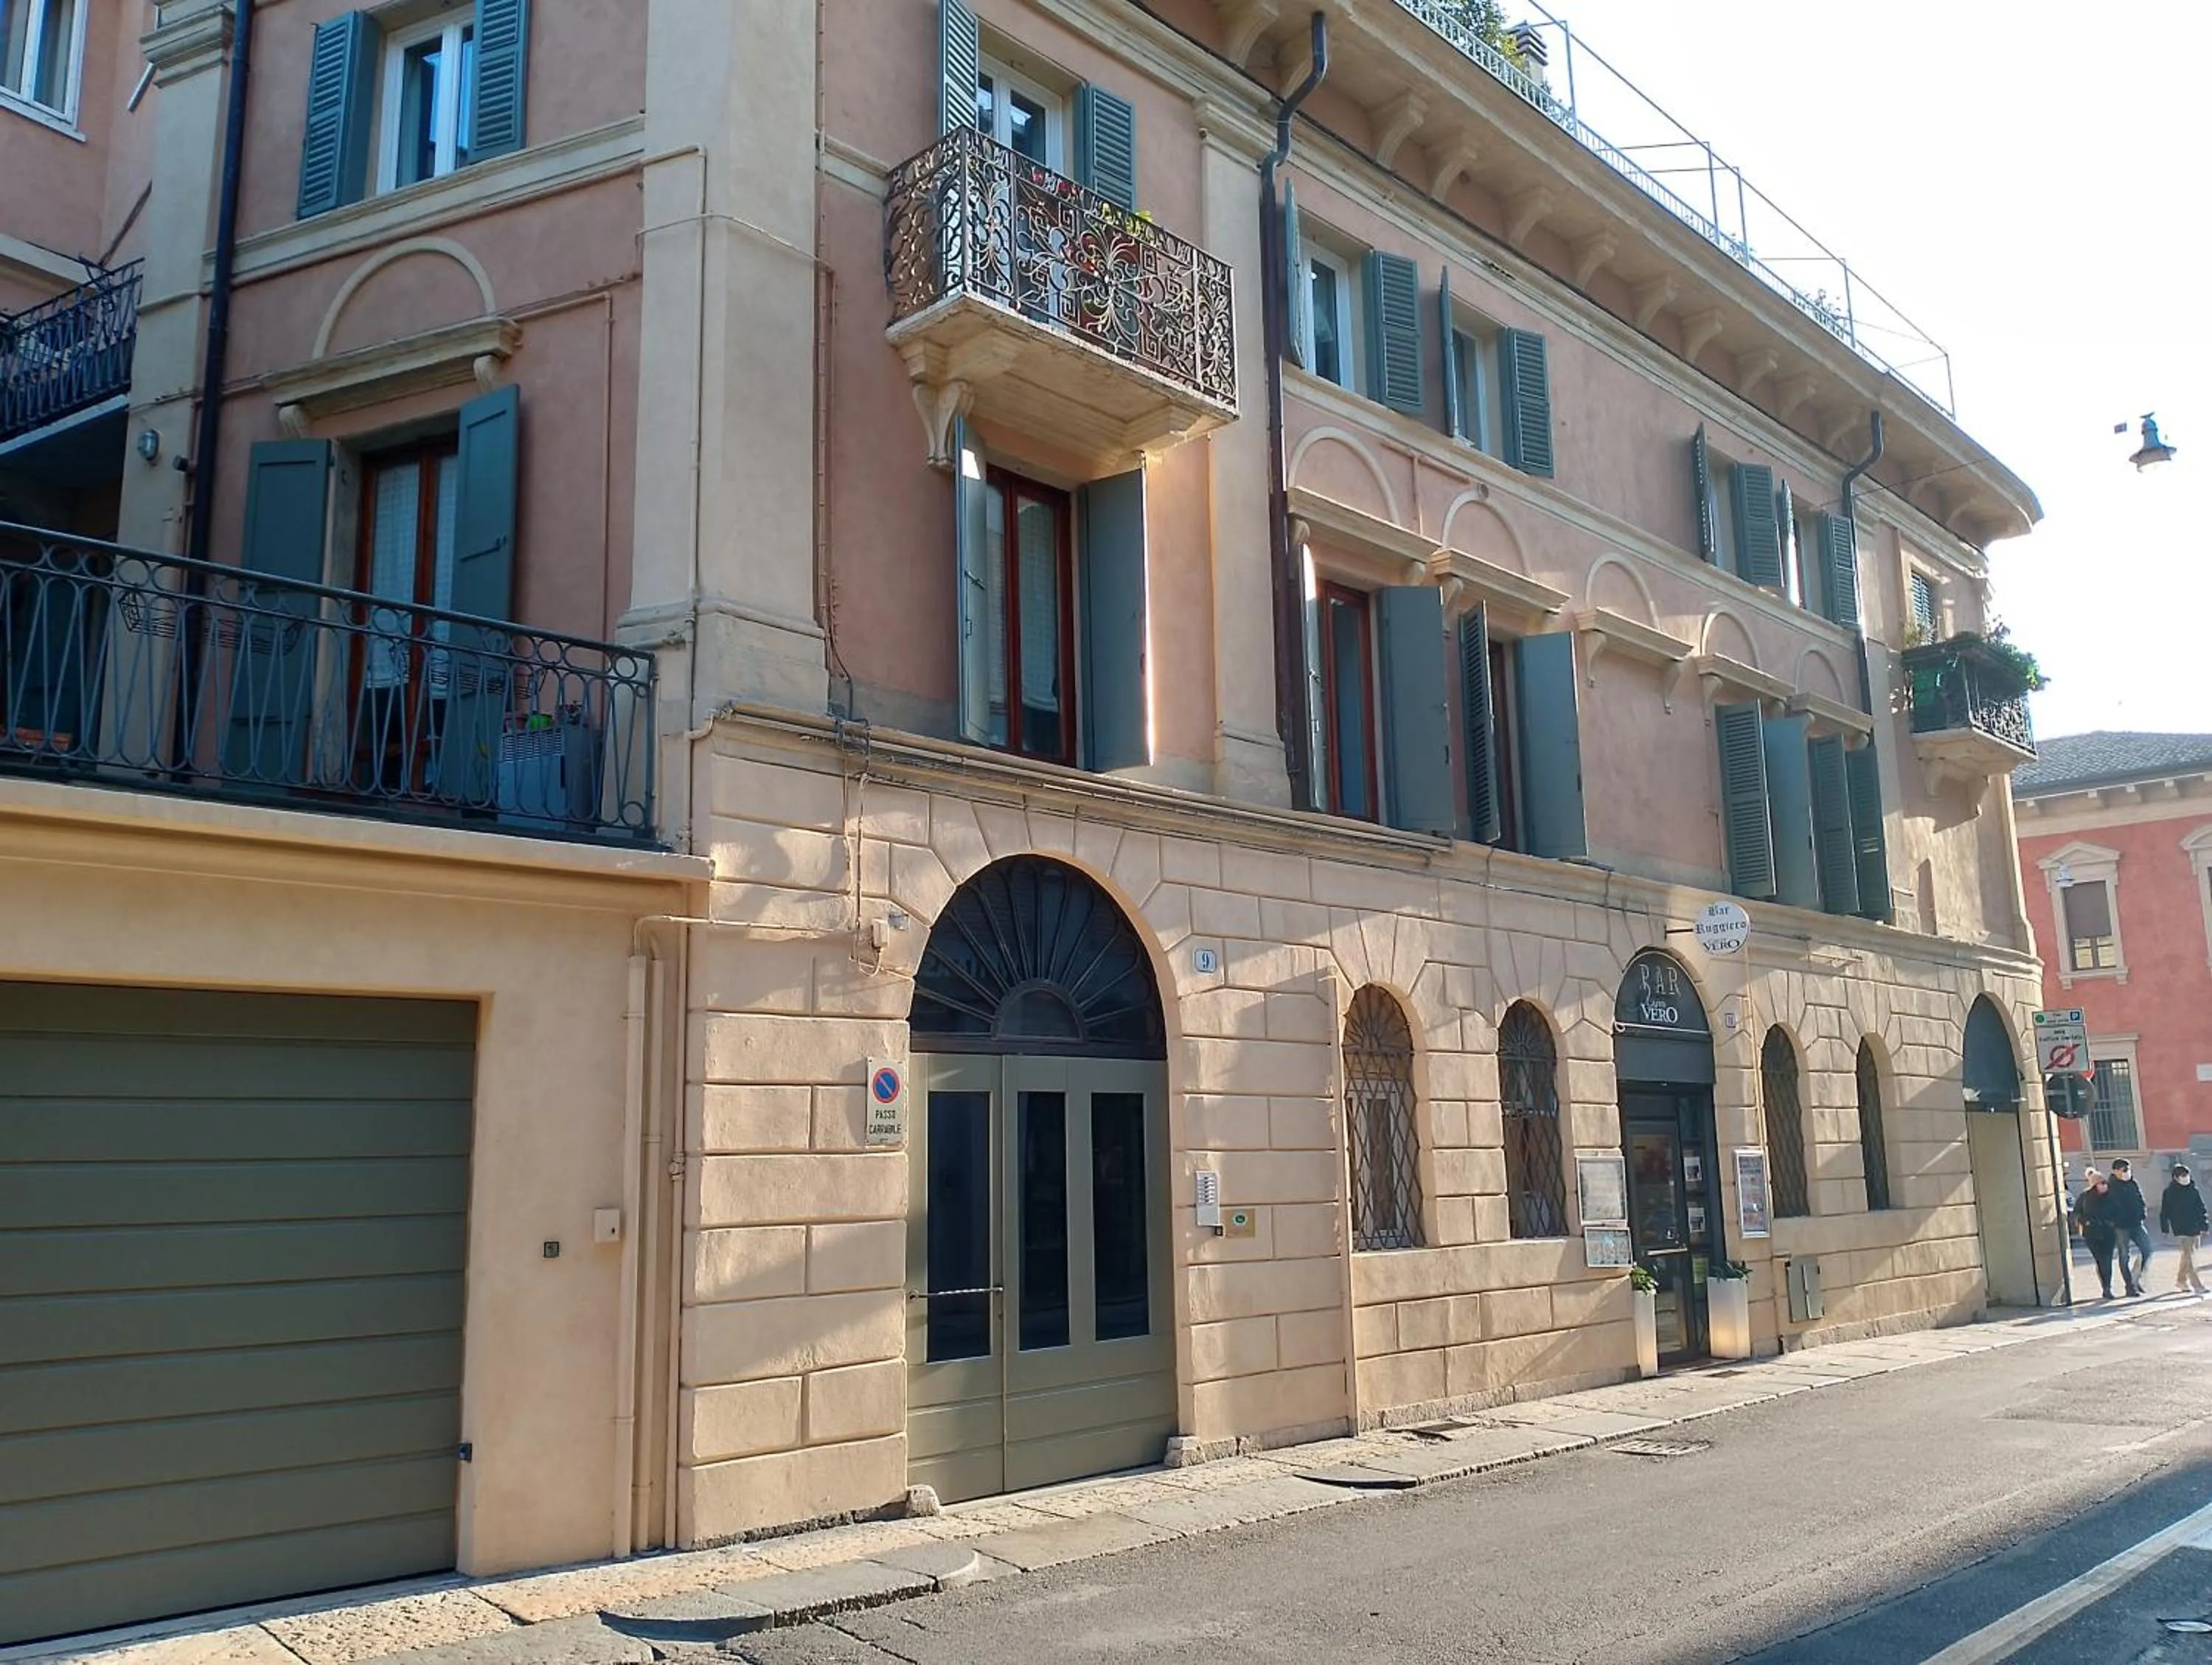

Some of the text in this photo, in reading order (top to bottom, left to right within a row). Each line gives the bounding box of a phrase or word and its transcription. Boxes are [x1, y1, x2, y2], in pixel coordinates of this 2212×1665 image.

[1703, 939, 1740, 951] VERO
[1202, 952, 1210, 969] 9
[1639, 964, 1680, 998] BAR
[1640, 1003, 1678, 1023] VERO
[875, 1110, 896, 1119] PASSO
[869, 1124, 901, 1134] CARRABILE
